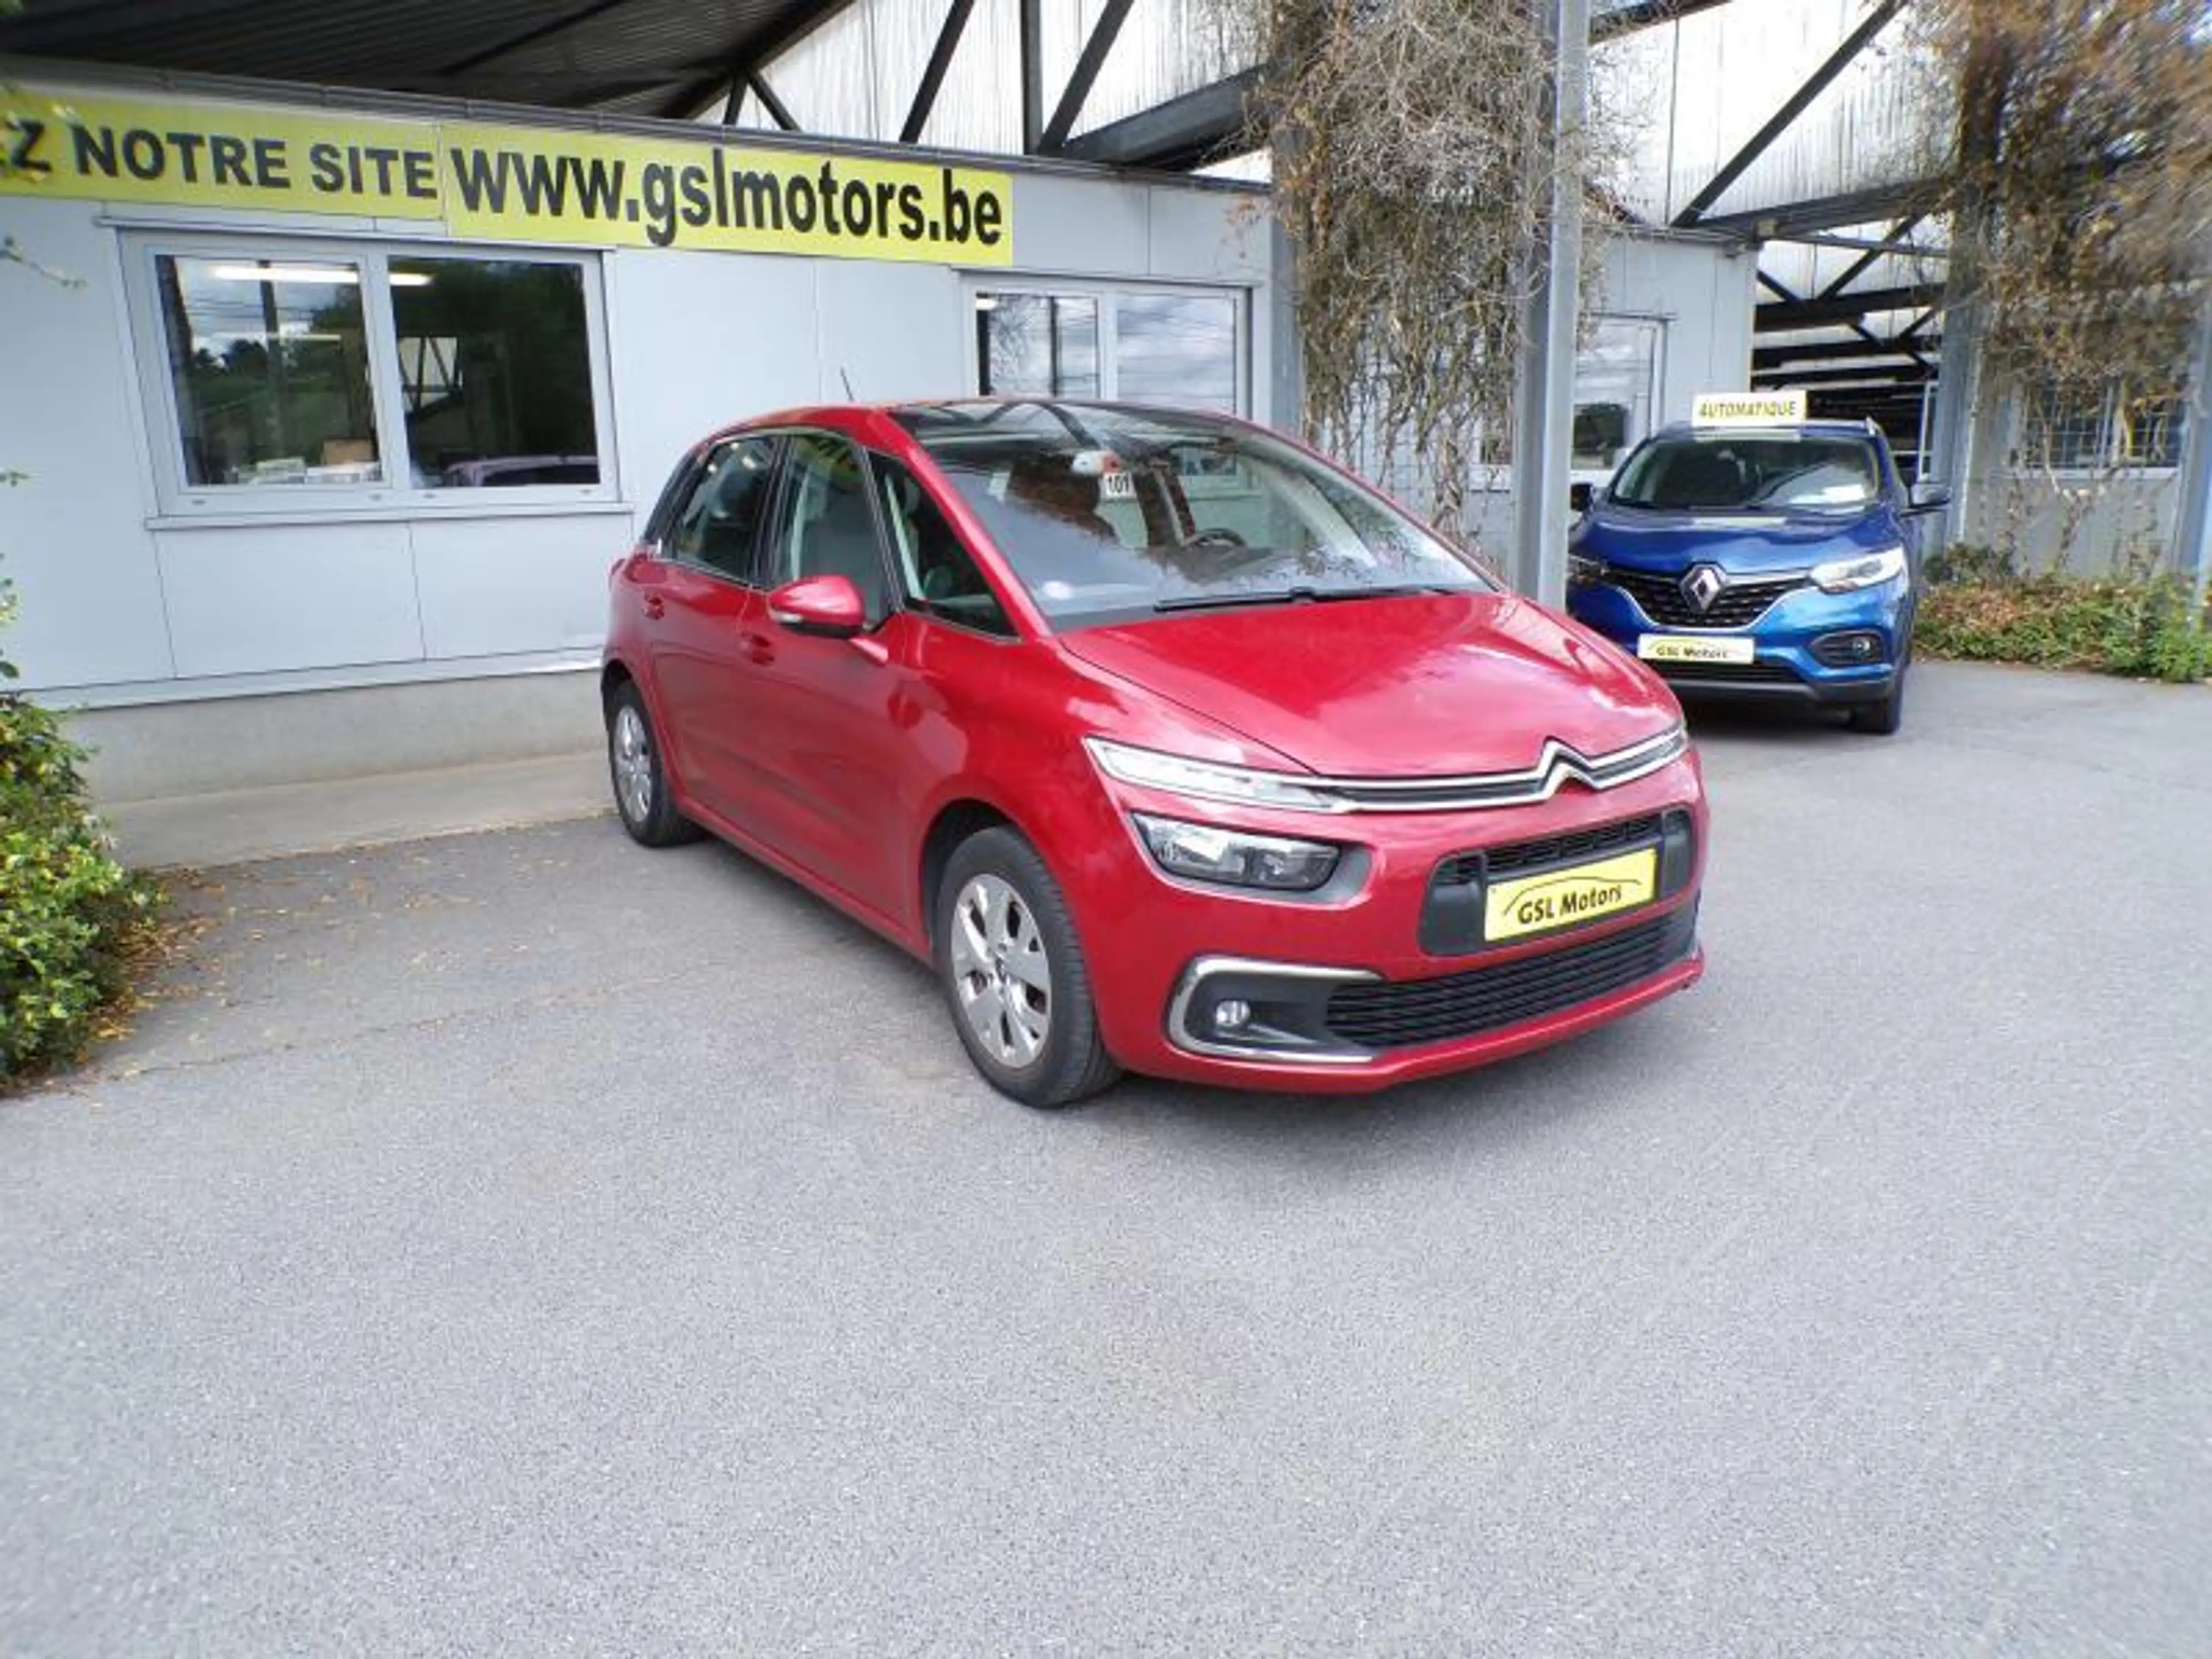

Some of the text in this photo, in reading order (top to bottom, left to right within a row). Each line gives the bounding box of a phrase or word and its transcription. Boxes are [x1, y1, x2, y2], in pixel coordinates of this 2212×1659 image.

[0, 119, 438, 199] Z NOTRE SITE
[1699, 400, 1797, 418] AUTOMATIQUE
[1517, 884, 1622, 925] GSL Motors
